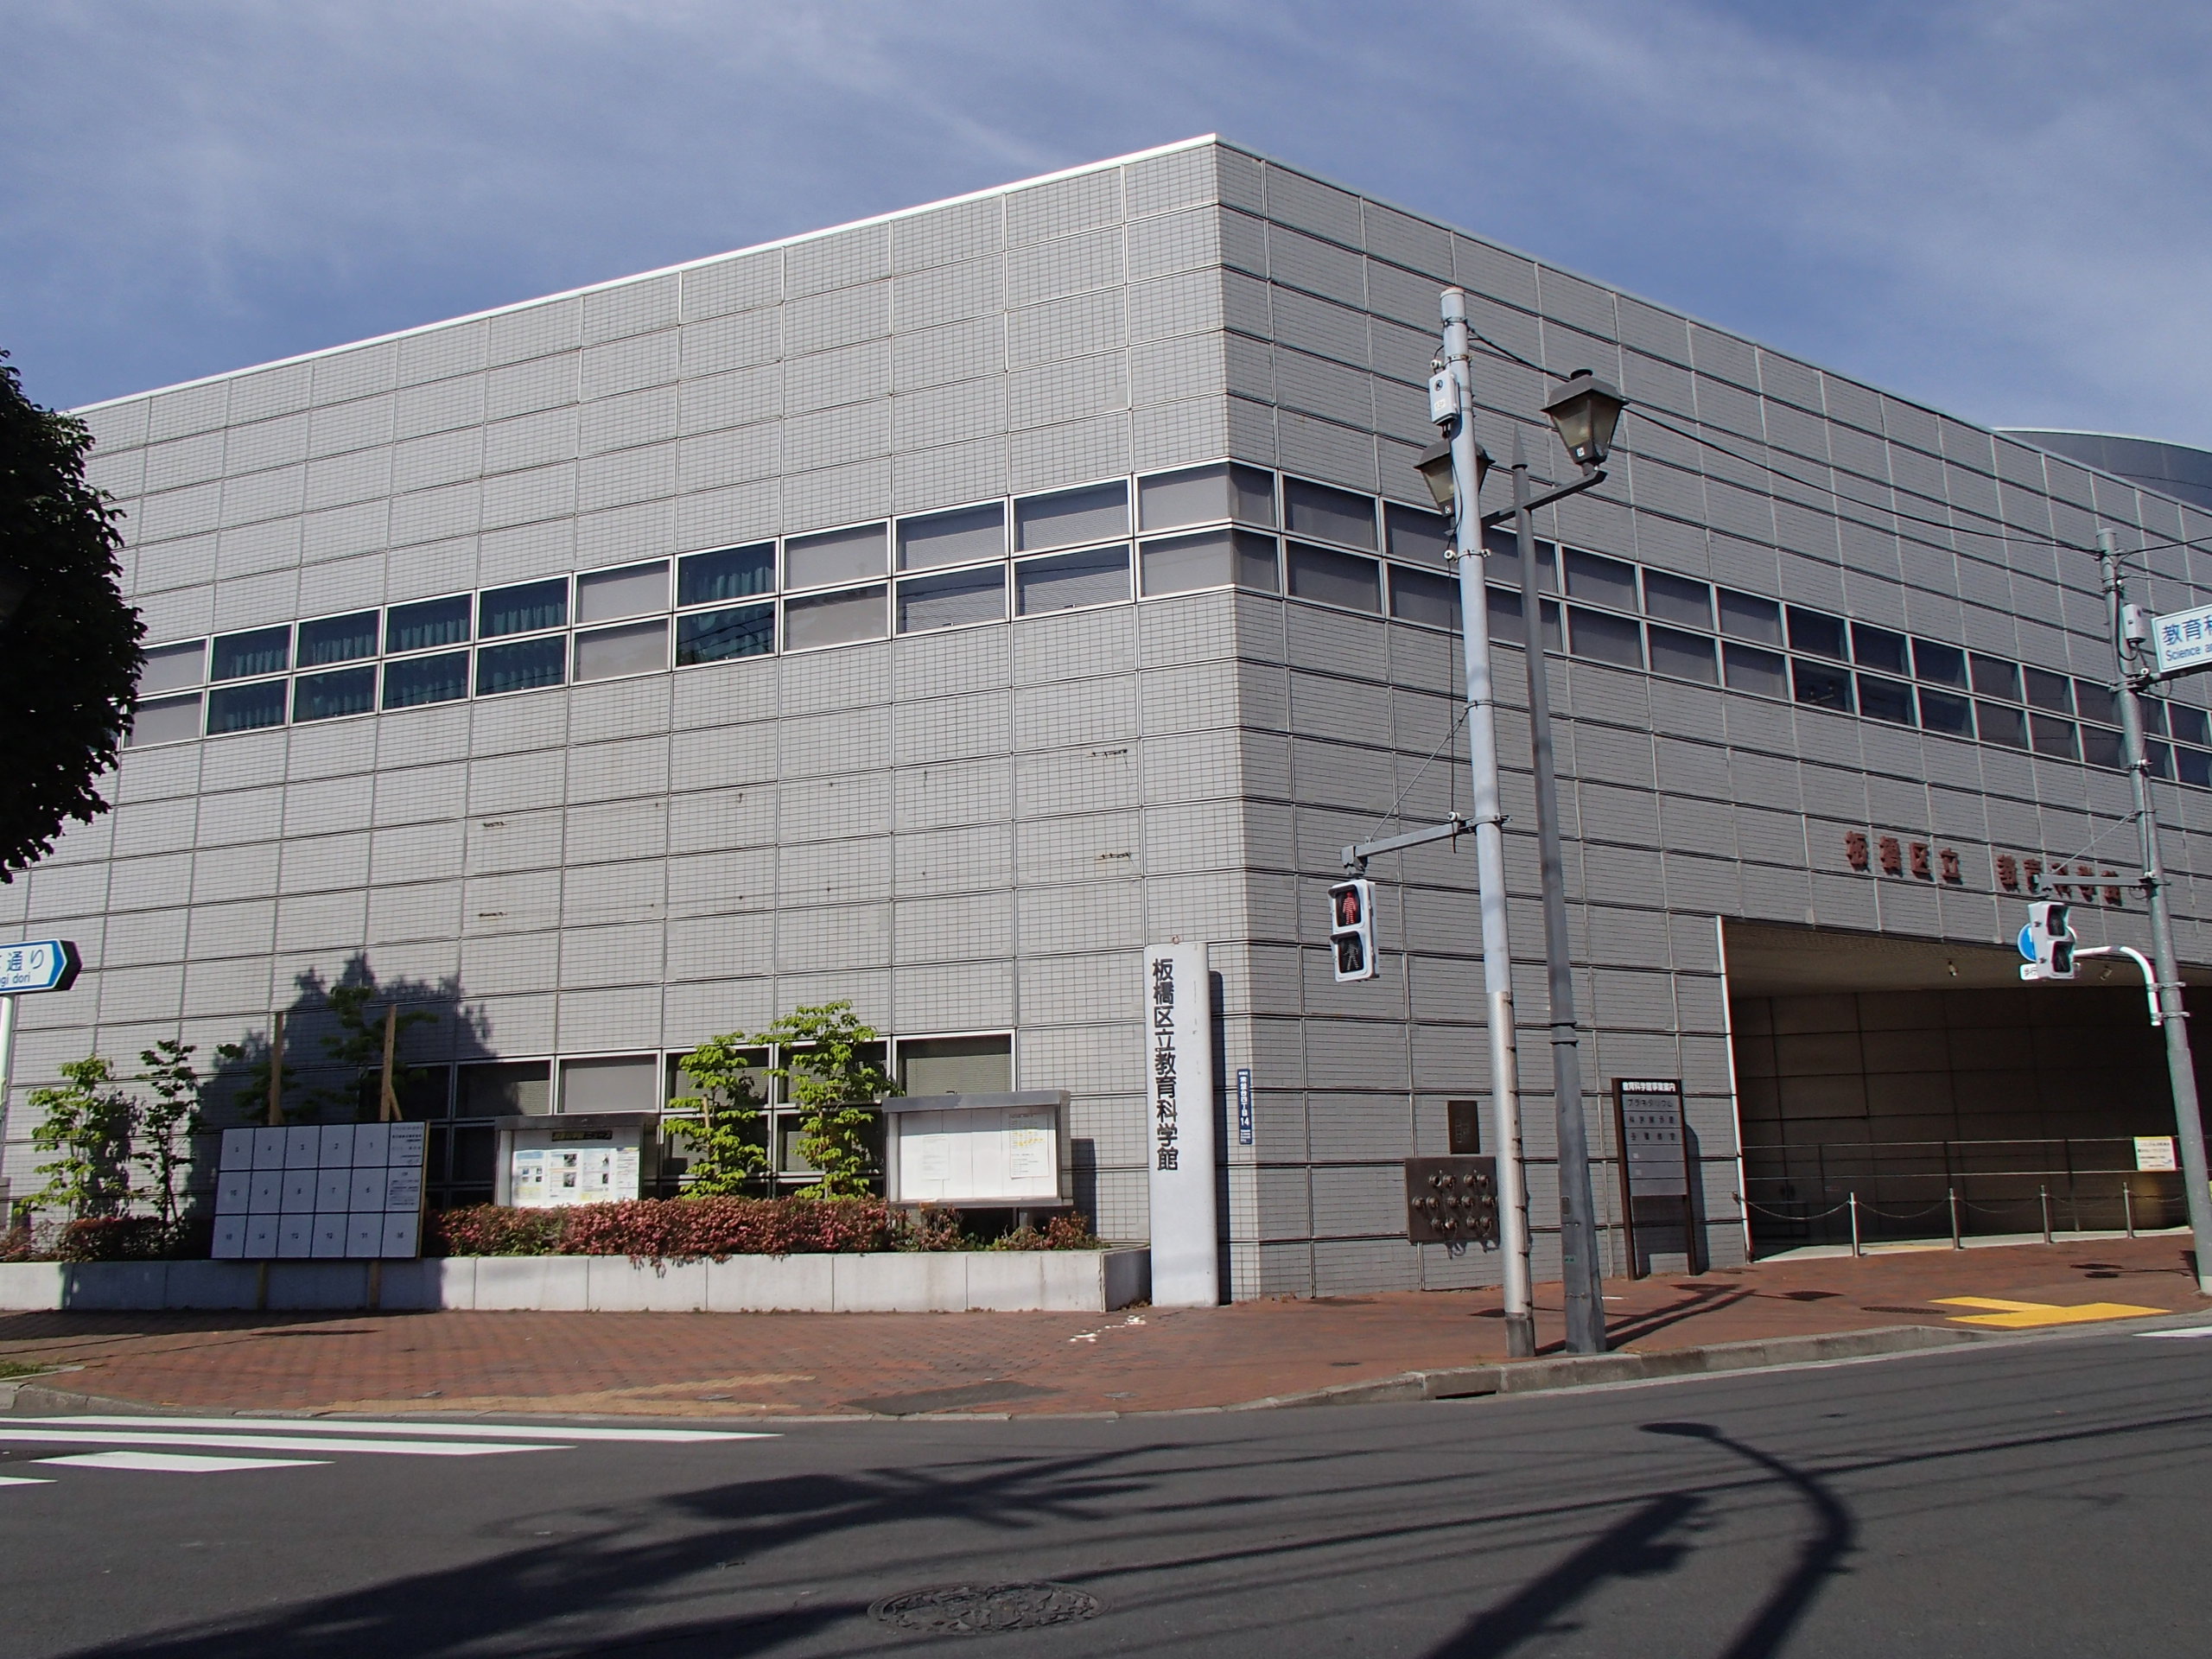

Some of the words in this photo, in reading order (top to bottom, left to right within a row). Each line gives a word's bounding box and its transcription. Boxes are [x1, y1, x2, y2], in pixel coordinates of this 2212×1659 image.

[2166, 646, 2200, 662] Science
[1844, 830, 1961, 880] 板橋区立
[0, 949, 44, 971] 通り
[13, 972, 30, 983] dori
[1152, 957, 1179, 1171] 板橋区立教育科学館
